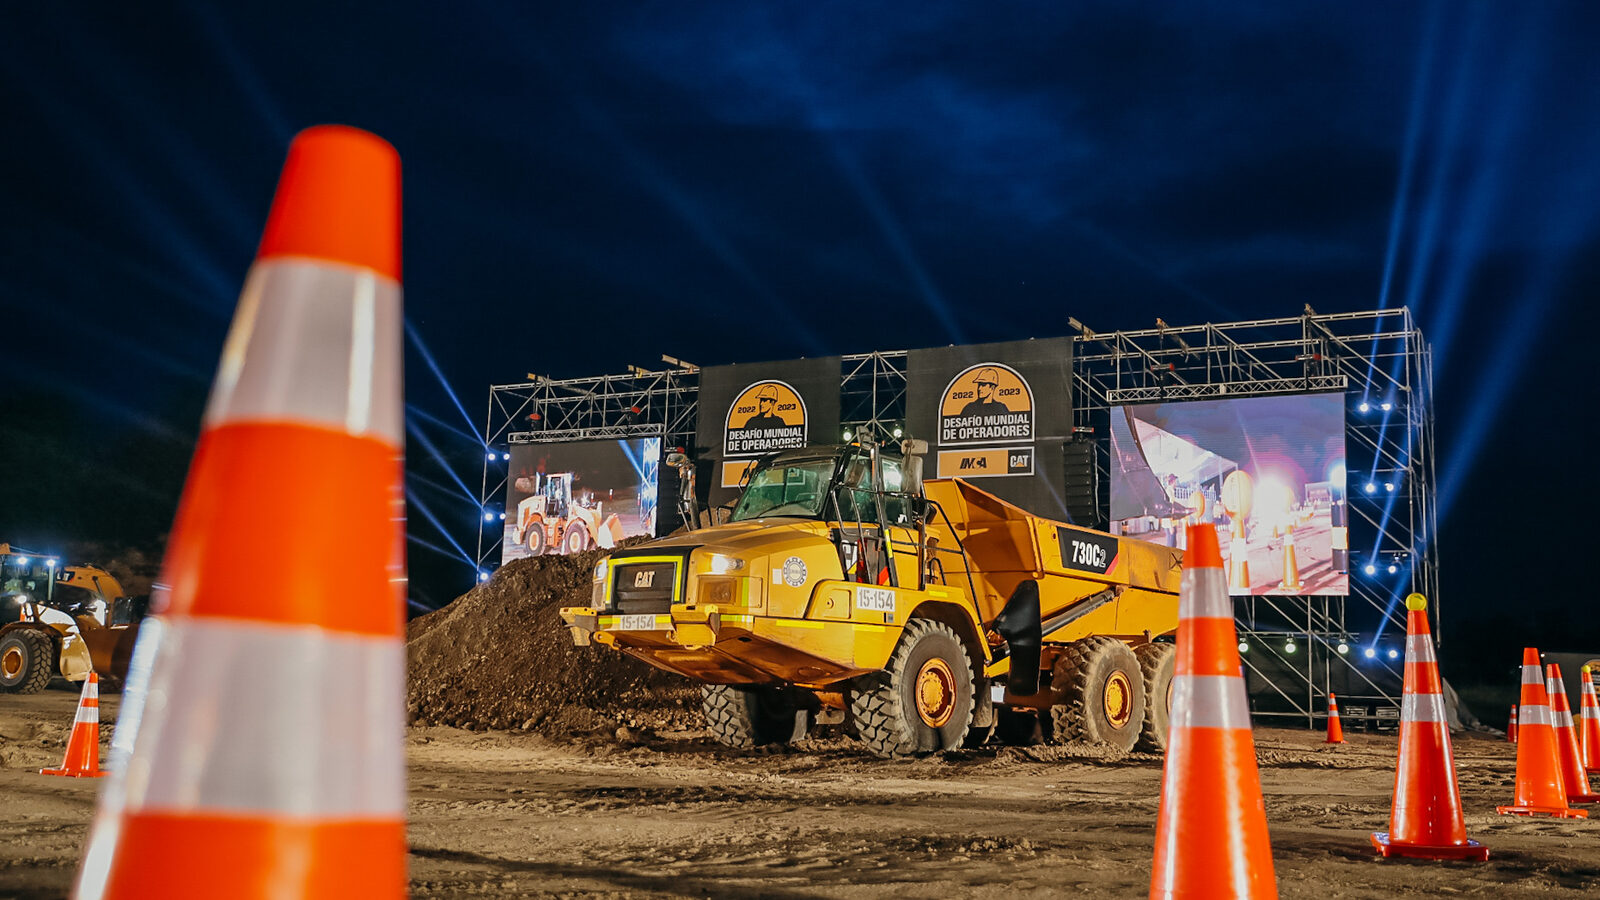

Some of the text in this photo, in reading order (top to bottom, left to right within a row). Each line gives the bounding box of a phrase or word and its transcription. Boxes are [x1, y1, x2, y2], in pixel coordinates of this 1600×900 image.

[952, 388, 1020, 400] 2022 2023
[737, 403, 797, 414] 2022 2023
[943, 414, 1030, 428] DESAFÍO MUNDIAL
[729, 426, 803, 440] DESAFÍO MUNDIAL
[943, 424, 1030, 440] DE OPERADORES
[728, 440, 740, 451] DE
[1010, 455, 1029, 468] CAT
[1072, 540, 1107, 568] 730C2
[634, 570, 656, 588] CAT
[859, 588, 893, 610] 15-154
[621, 615, 654, 630] 15-154
